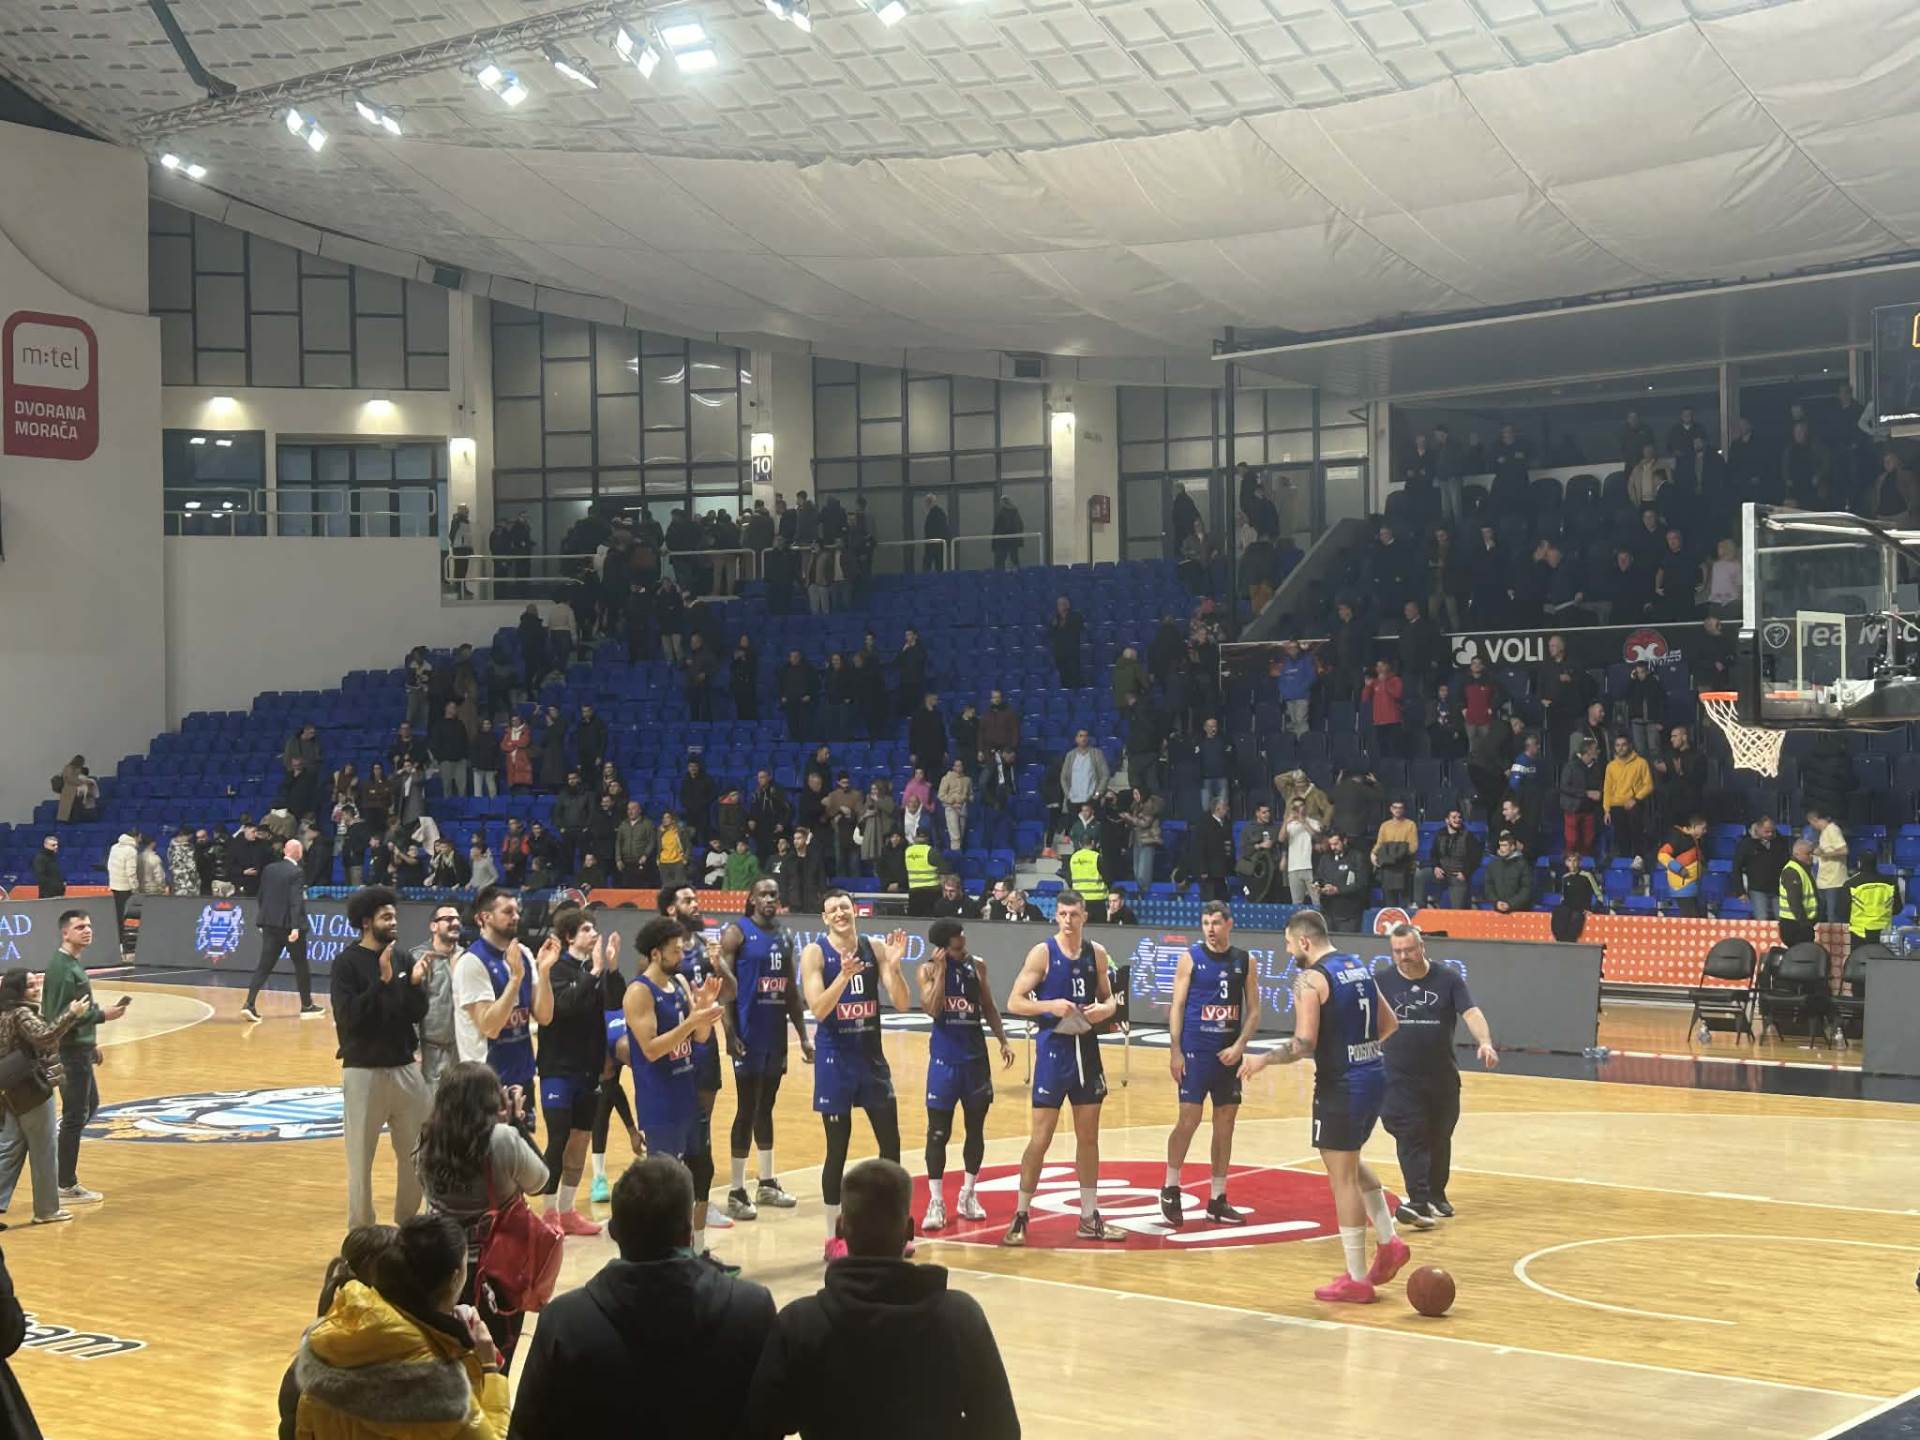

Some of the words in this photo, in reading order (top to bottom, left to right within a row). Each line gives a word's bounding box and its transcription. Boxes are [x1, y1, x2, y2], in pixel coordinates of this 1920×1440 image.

[22, 346, 79, 370] m:tel
[15, 400, 87, 420] DVORANA
[15, 421, 79, 440] MORAČA
[753, 456, 771, 473] 10
[1484, 637, 1544, 663] VOLI
[770, 951, 782, 970] 16
[850, 974, 864, 995] 10
[1072, 978, 1086, 998] 13
[1220, 980, 1228, 998] 3
[840, 1003, 875, 1018] VOLI
[1358, 998, 1371, 1039] 7
[1314, 1119, 1321, 1142] 7
